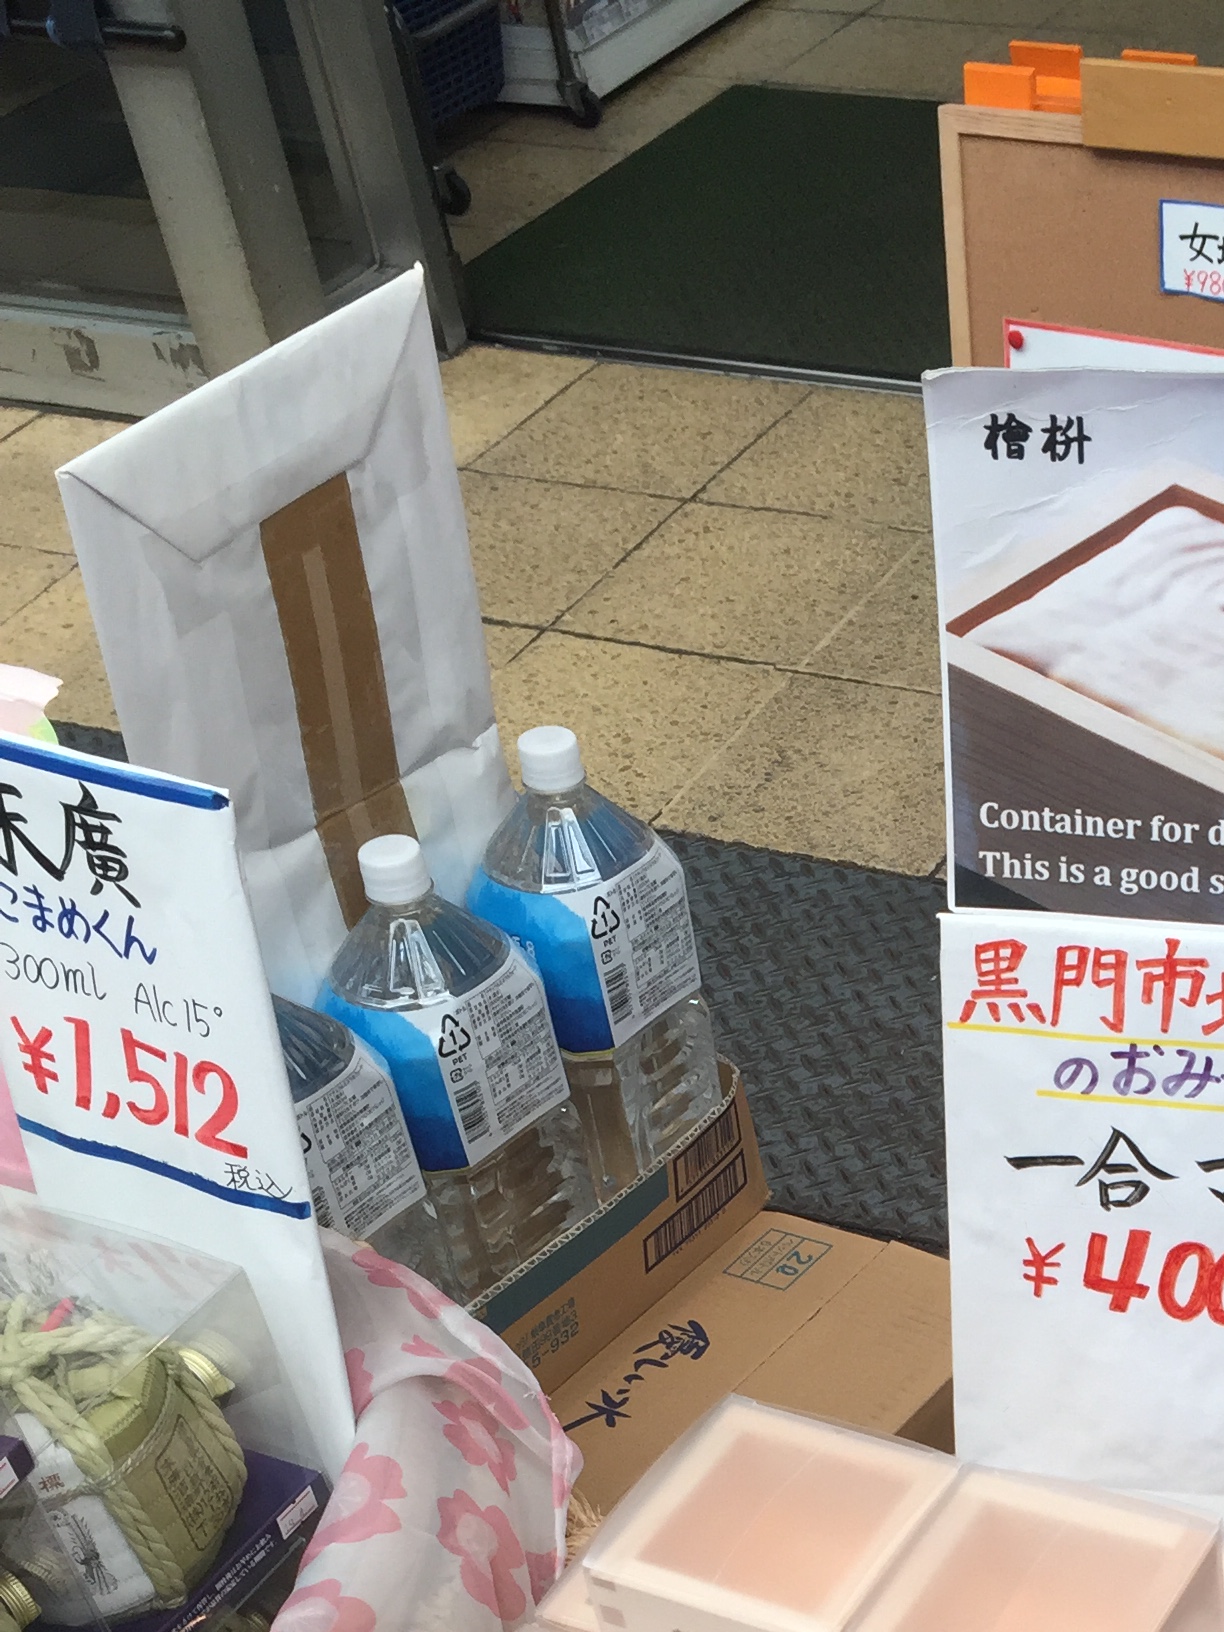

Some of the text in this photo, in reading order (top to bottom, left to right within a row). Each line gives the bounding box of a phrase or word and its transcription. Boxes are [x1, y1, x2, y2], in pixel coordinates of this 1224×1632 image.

[979, 802, 1141, 842] Container
[1149, 815, 1200, 845] for
[979, 850, 1050, 881] This
[1058, 855, 1086, 884] is
[1093, 865, 1112, 888] a
[1120, 866, 1201, 895] good
[452, 1052, 468, 1066] PET
[10, 1015, 249, 1160] ¥1,512
[224, 1162, 292, 1200] 税込
